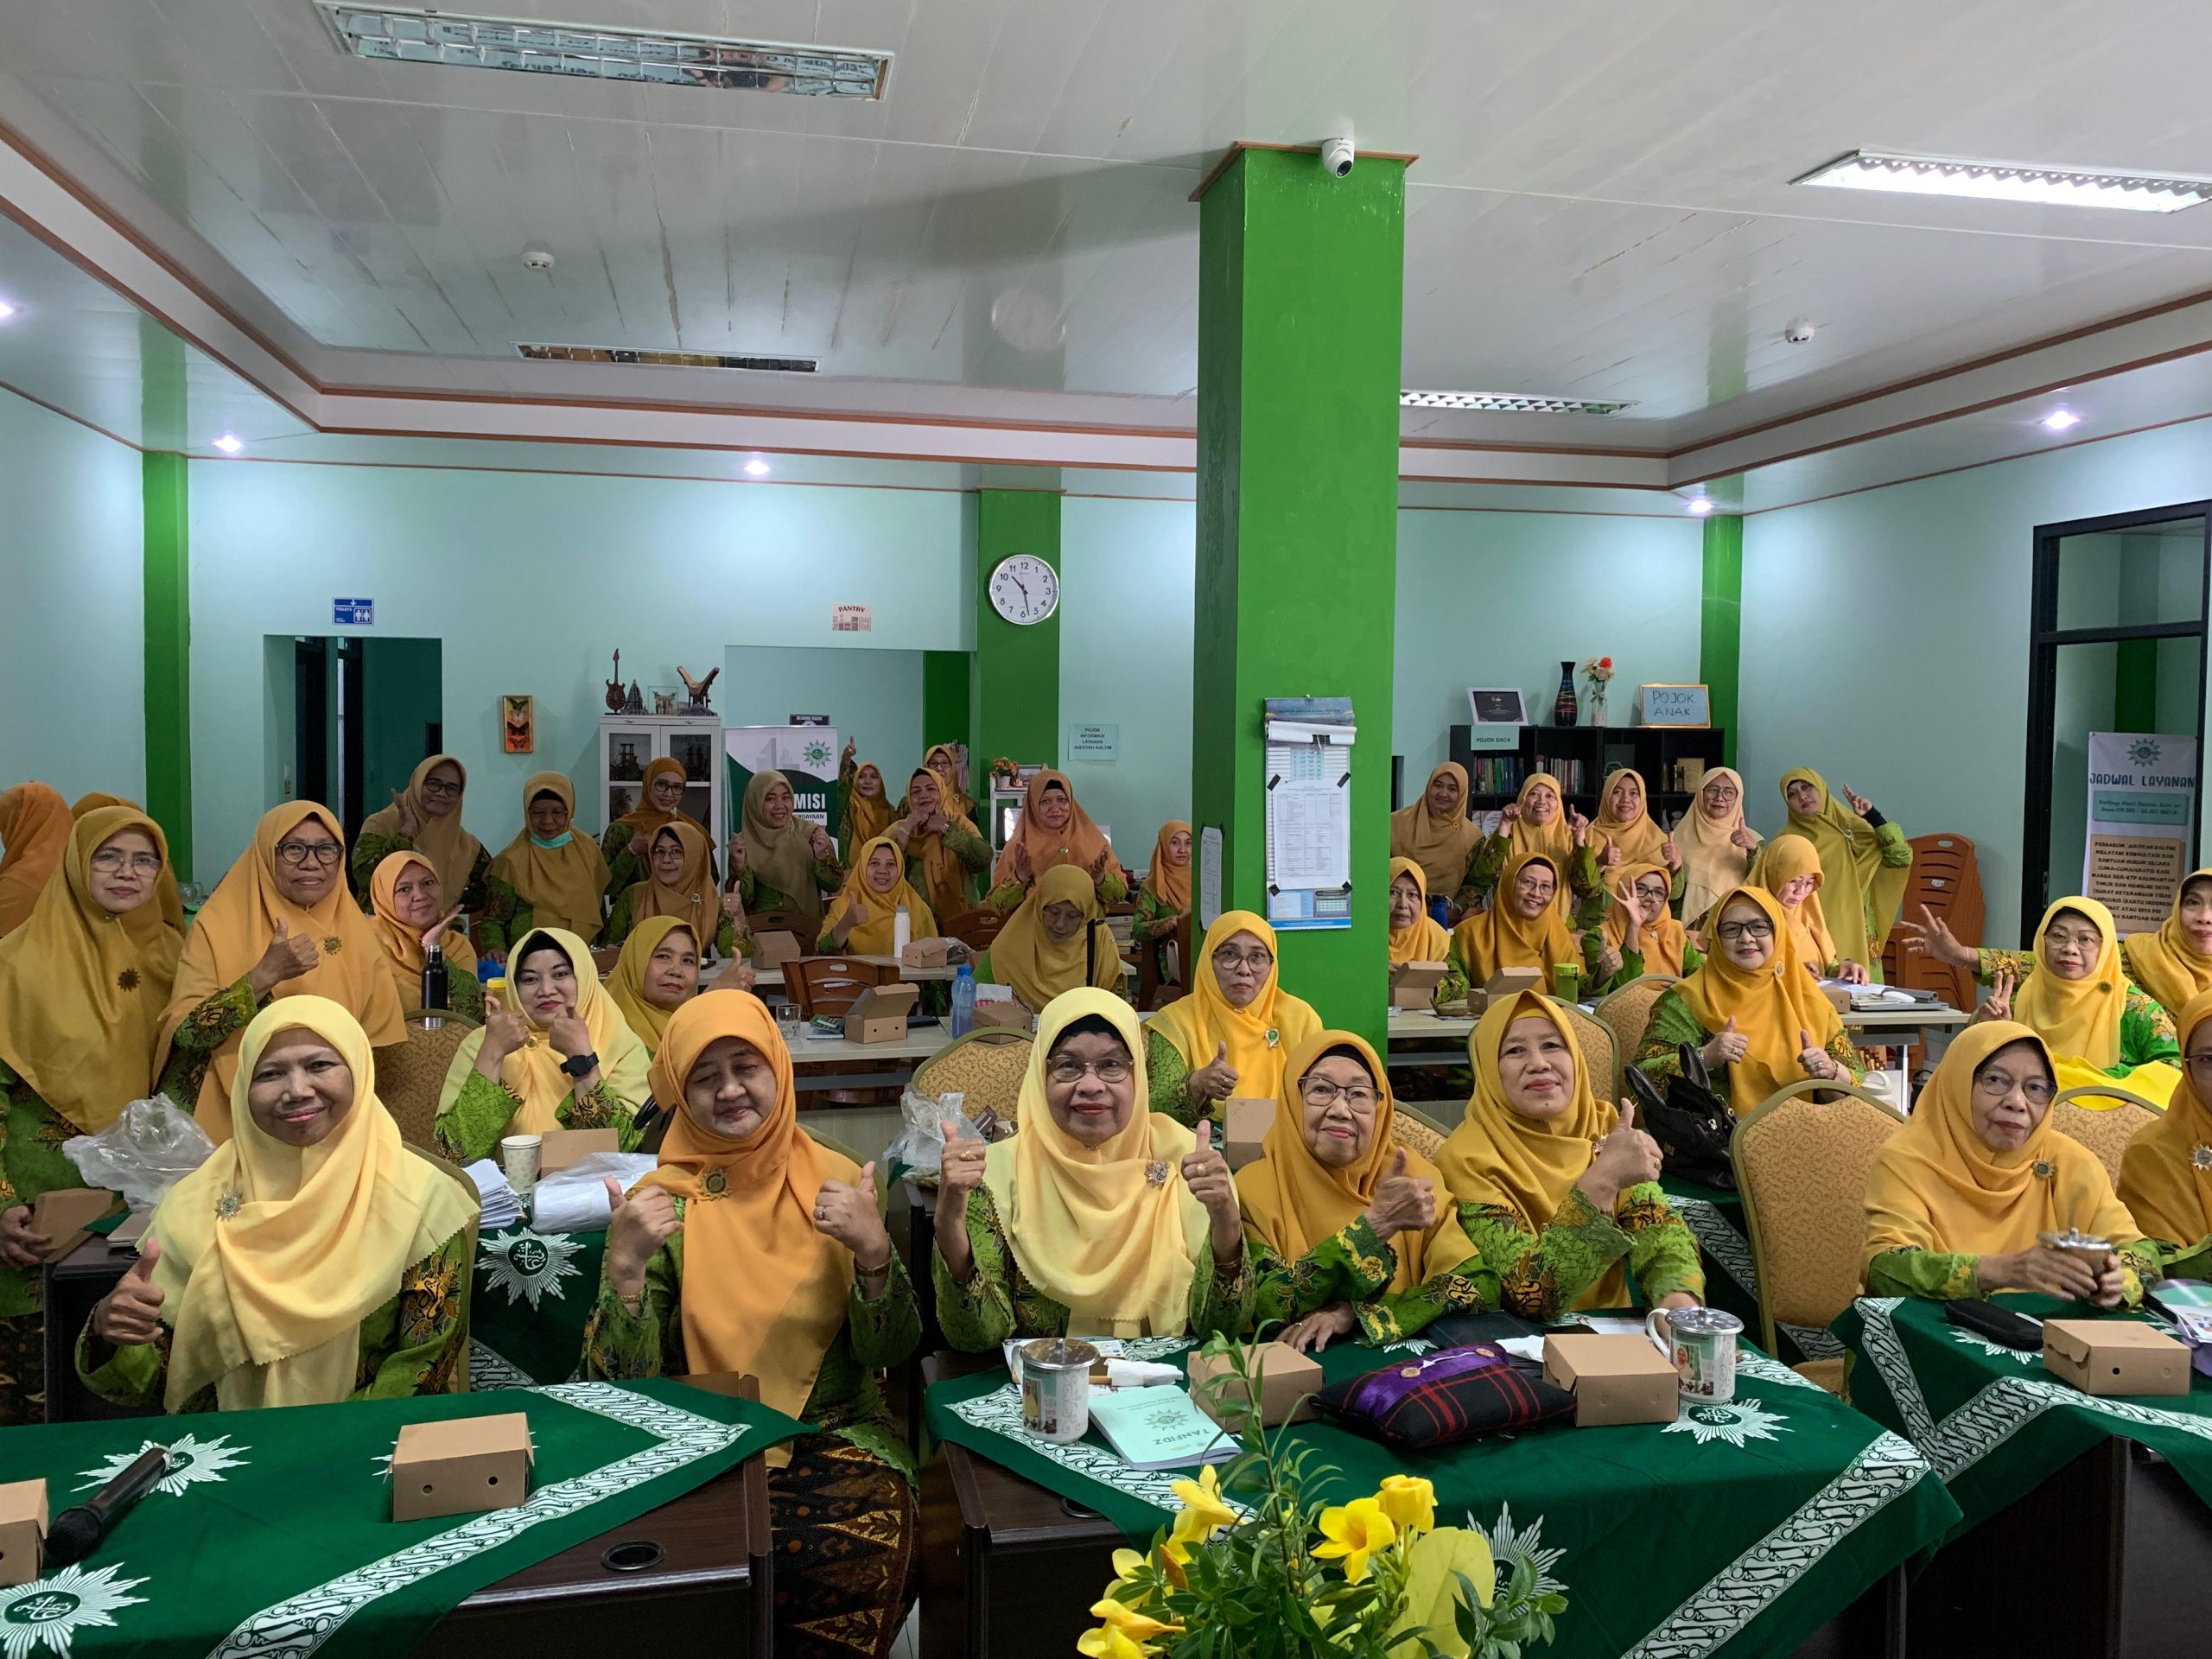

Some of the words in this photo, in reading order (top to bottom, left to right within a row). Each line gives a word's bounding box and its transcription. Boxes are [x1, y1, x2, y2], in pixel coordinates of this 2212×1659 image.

[1033, 607, 1039, 615] 5
[1652, 690, 1694, 704] POJOK
[1654, 707, 1691, 716] ANAK
[2089, 772, 2135, 785] JADWAL
[2141, 775, 2195, 788] LAYANAN
[793, 793, 826, 810] MISI
[1153, 1428, 1211, 1446] TANFIDZ
